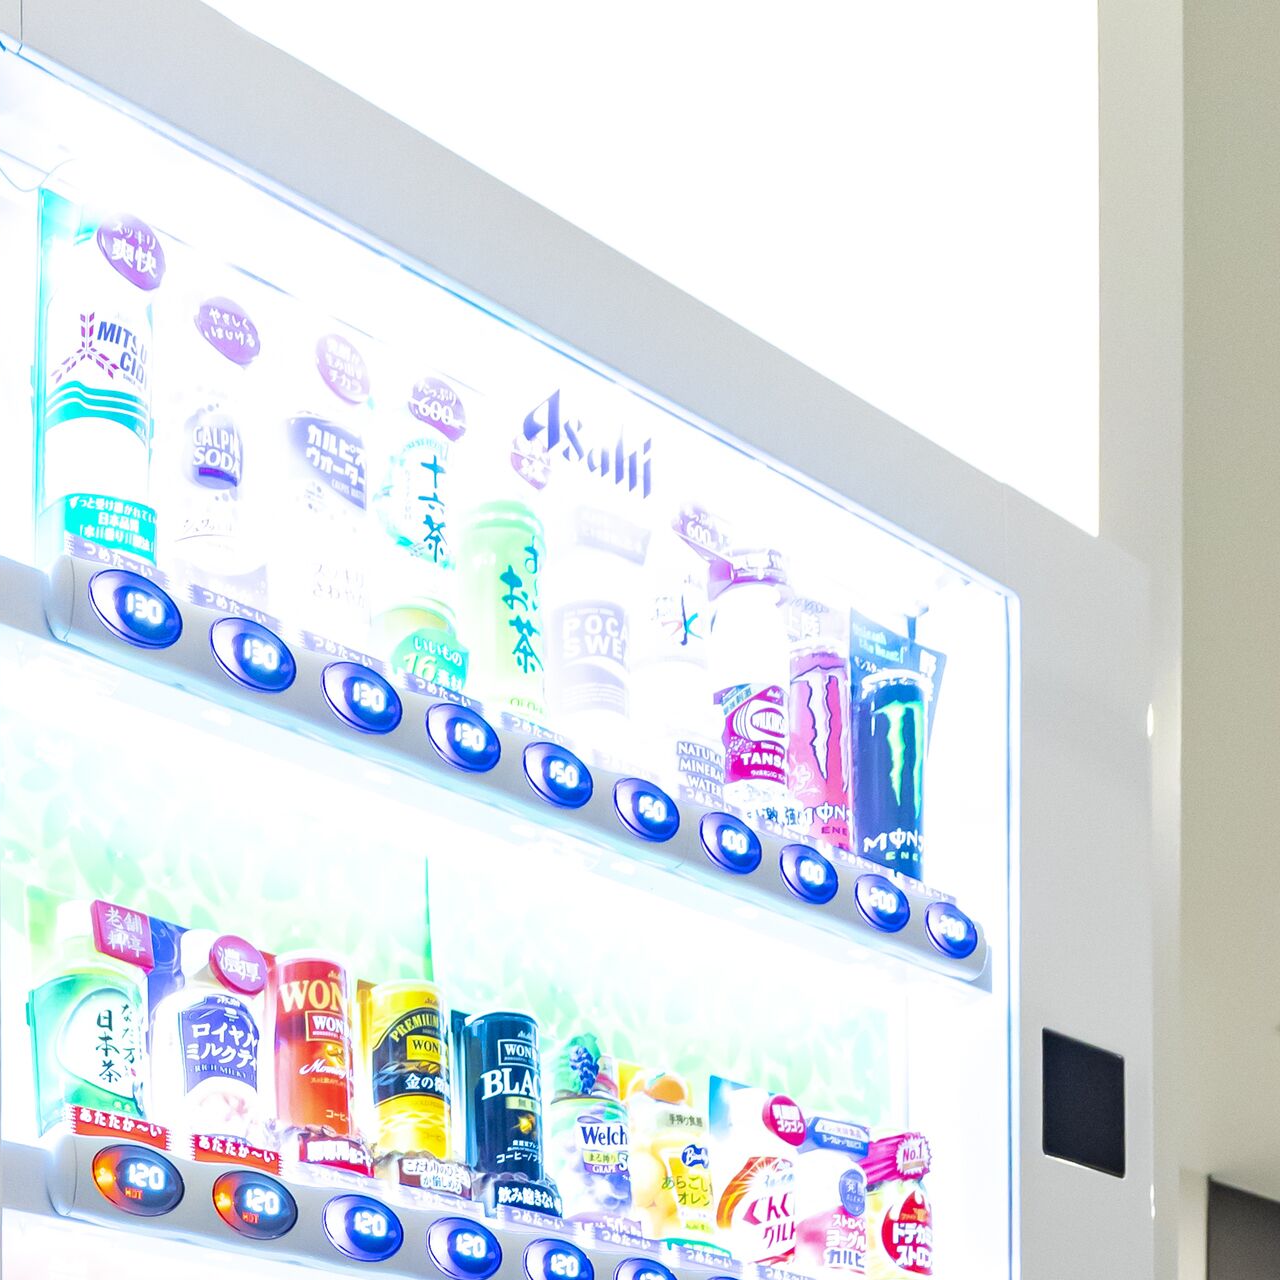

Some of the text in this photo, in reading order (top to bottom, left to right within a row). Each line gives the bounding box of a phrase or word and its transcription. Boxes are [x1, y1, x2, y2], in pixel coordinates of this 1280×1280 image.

[111, 237, 158, 279] 爽快
[522, 388, 652, 499] Asahi
[418, 454, 448, 564] 十六茶
[127, 592, 163, 626] 130
[500, 564, 544, 675] お茶
[244, 638, 278, 672] 130
[353, 681, 385, 713] 130
[455, 722, 486, 752] 130
[549, 760, 579, 789] 150
[638, 796, 667, 824] 150
[96, 1009, 122, 1083] 日本茶
[192, 1022, 260, 1051] ロイヤル
[902, 1147, 924, 1163] No.1
[129, 1157, 166, 1192] 120
[125, 1189, 144, 1201] HOT
[246, 1186, 280, 1214] 120
[353, 1211, 387, 1238] 120
[456, 1233, 487, 1258] 120
[551, 1253, 580, 1277] 120
